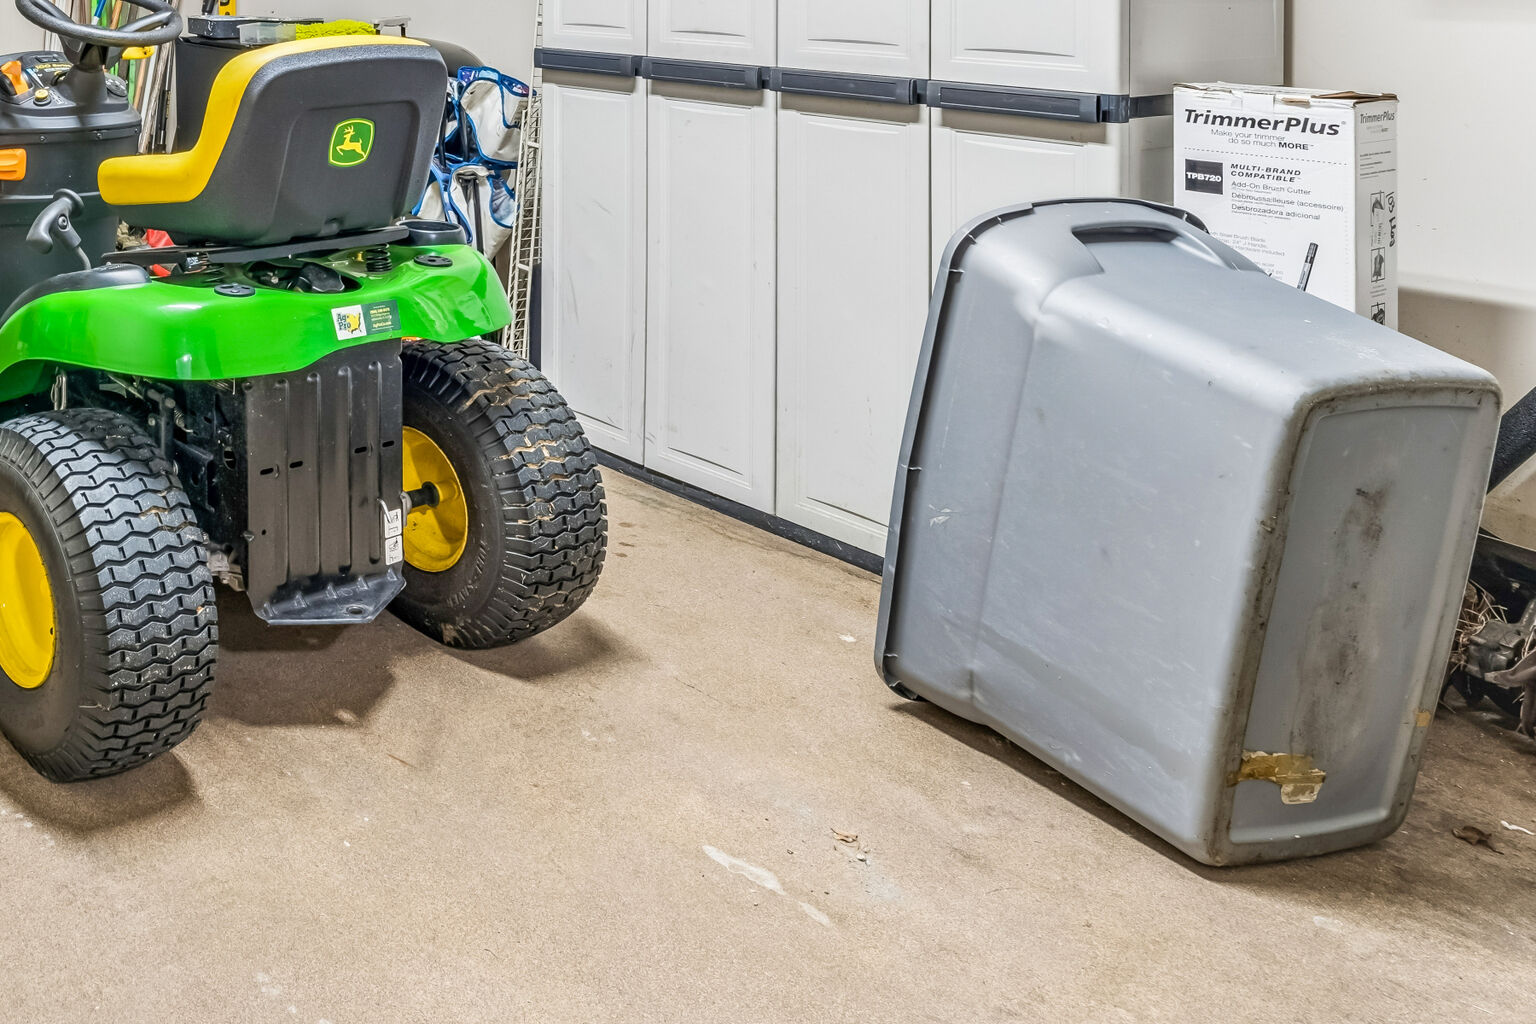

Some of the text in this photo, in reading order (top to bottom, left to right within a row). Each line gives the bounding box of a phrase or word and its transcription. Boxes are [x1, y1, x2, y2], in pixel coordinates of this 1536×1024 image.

[1184, 108, 1341, 136] TrimmerPlus
[1360, 111, 1395, 124] TrimmerPlus
[1211, 128, 1286, 141] Make your trimmer
[1253, 139, 1276, 147] much
[1278, 141, 1309, 151] MORE
[1230, 163, 1302, 176] MULTI-BRAND
[1185, 171, 1222, 183] TPB720
[1230, 170, 1296, 183] COMPATIBLE
[1231, 180, 1261, 190] Add-On
[1286, 186, 1312, 196] Cutter
[1231, 203, 1285, 216] Desbrozadora
